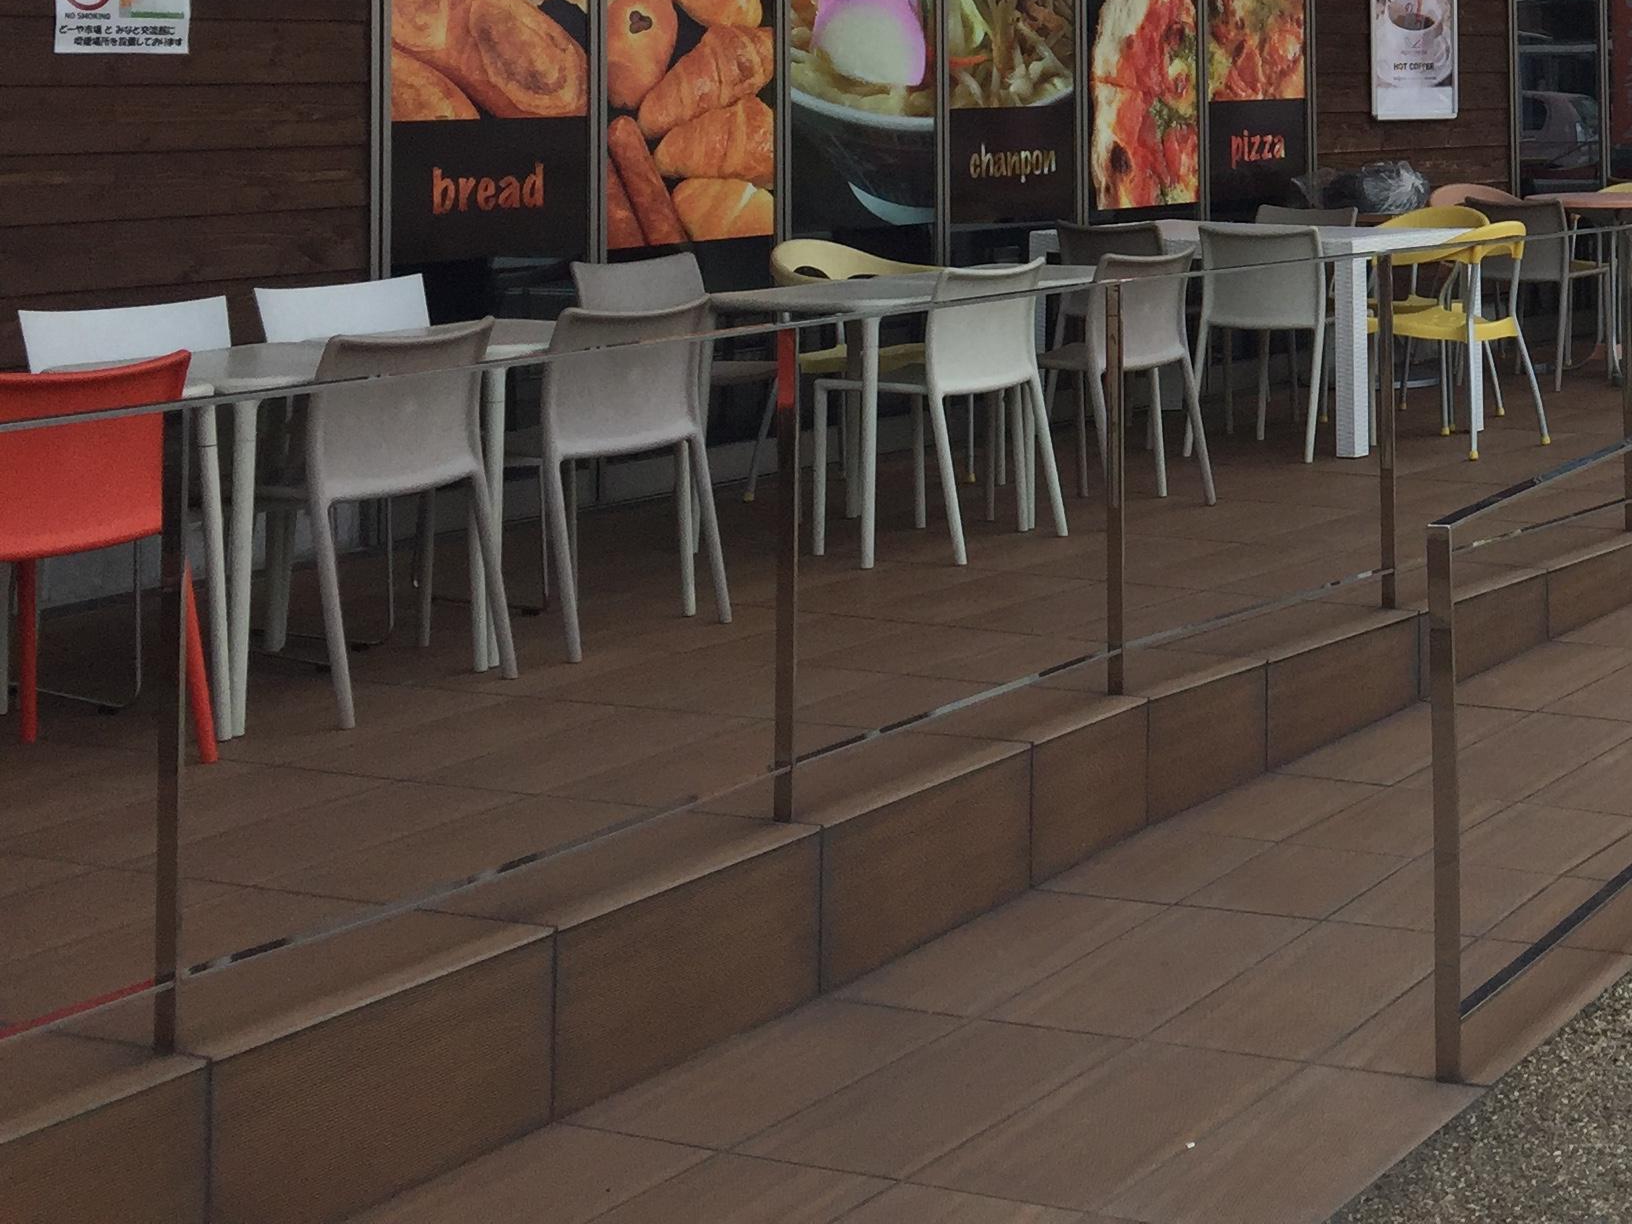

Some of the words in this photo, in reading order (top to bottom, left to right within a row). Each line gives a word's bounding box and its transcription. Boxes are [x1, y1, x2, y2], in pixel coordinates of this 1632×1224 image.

[65, 12, 75, 20] NO
[77, 12, 112, 21] SMOKING
[969, 142, 1056, 183] chanpon
[1231, 129, 1285, 169] pizza
[433, 158, 544, 215] bread
